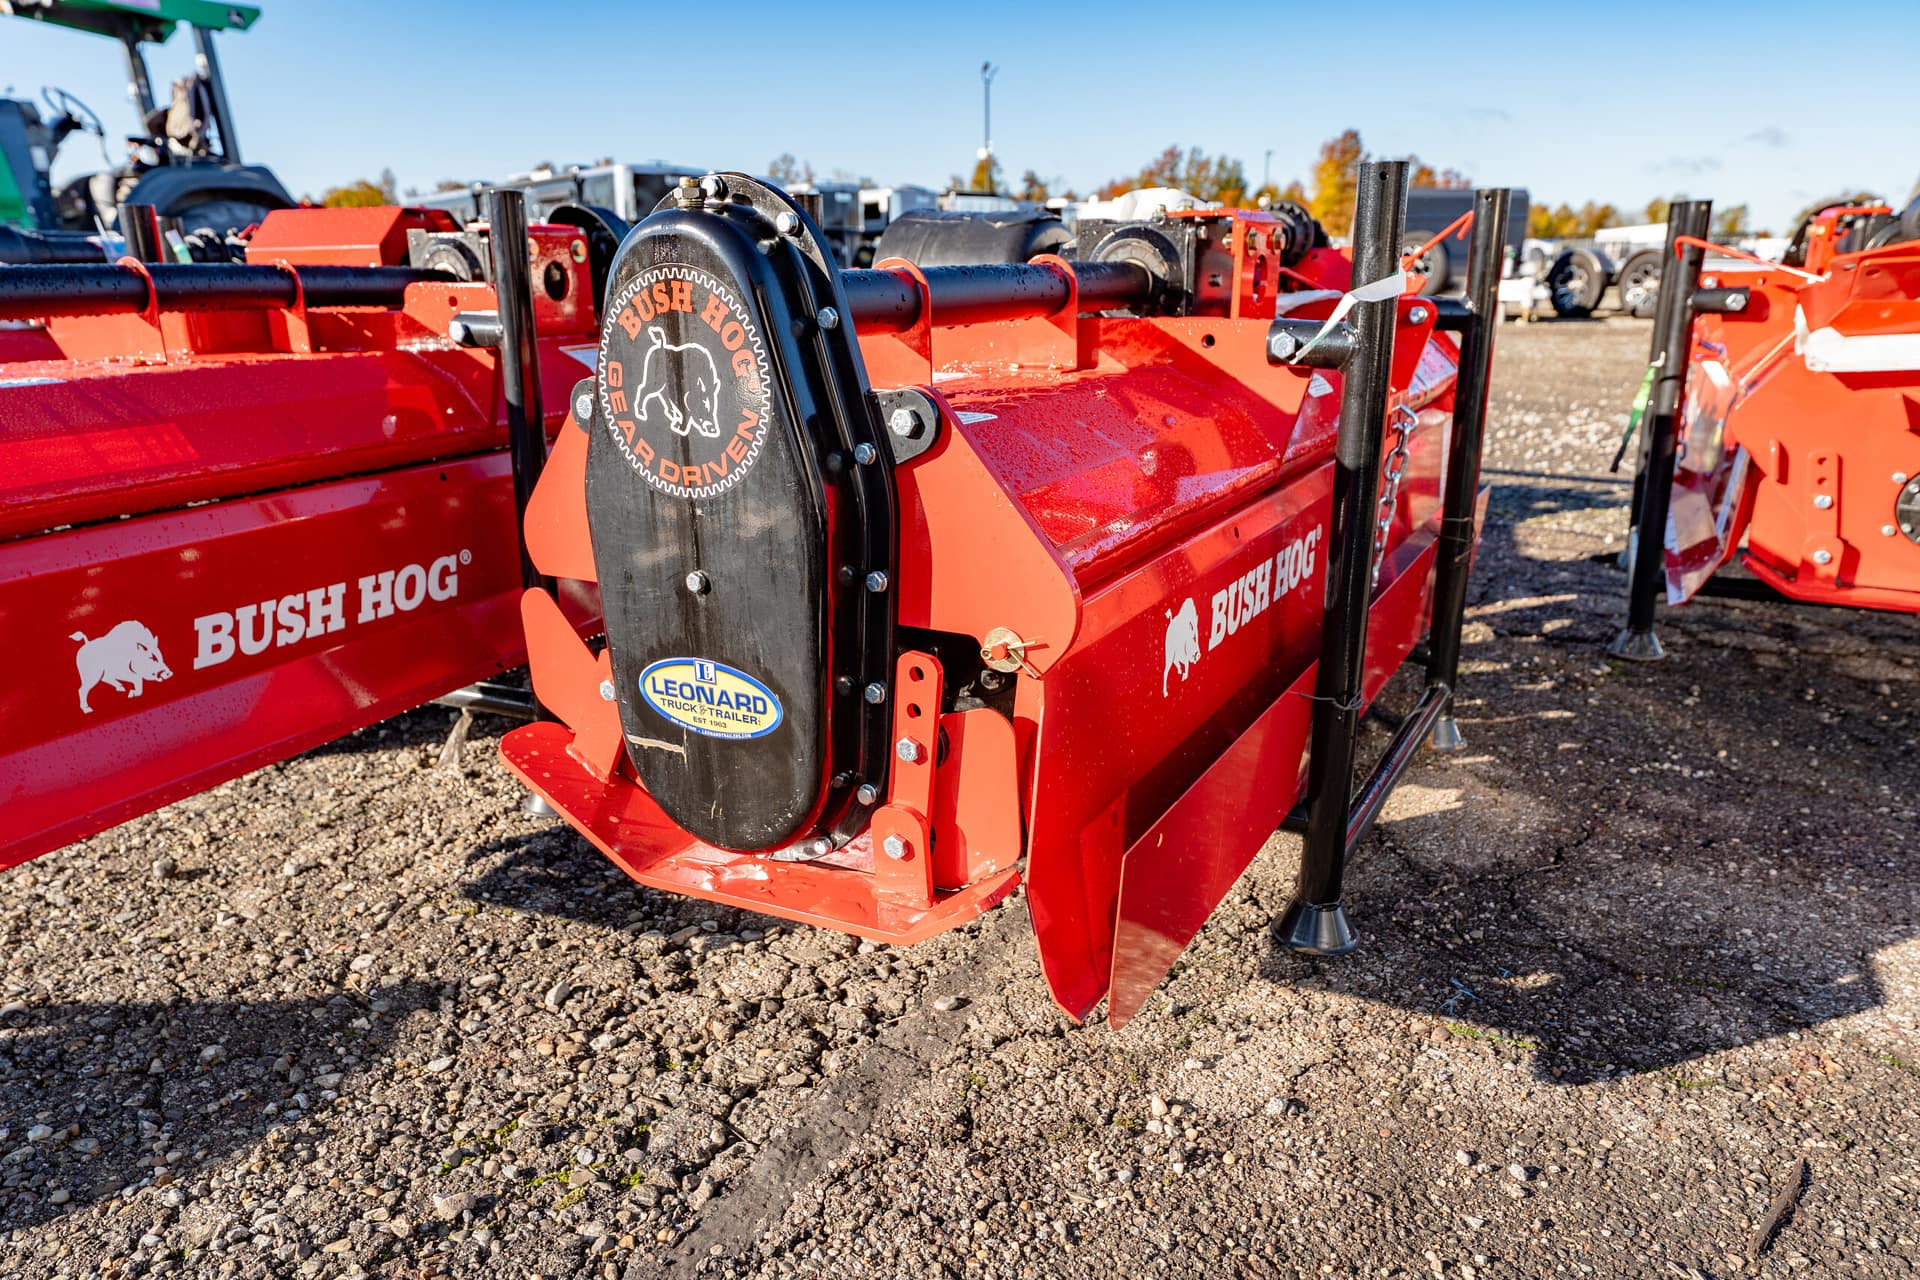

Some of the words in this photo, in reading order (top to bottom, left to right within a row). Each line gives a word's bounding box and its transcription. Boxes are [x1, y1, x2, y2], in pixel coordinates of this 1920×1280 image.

[617, 280, 693, 341] BUSH
[608, 360, 656, 467] GEAR
[659, 408, 762, 487] DRIVEN
[193, 582, 346, 670] BUSH
[1208, 558, 1273, 652] BUSH
[651, 676, 767, 715] LEONARD
[660, 698, 697, 714] TRUCK
[693, 715, 707, 724] EST
[709, 719, 727, 730] 1963
